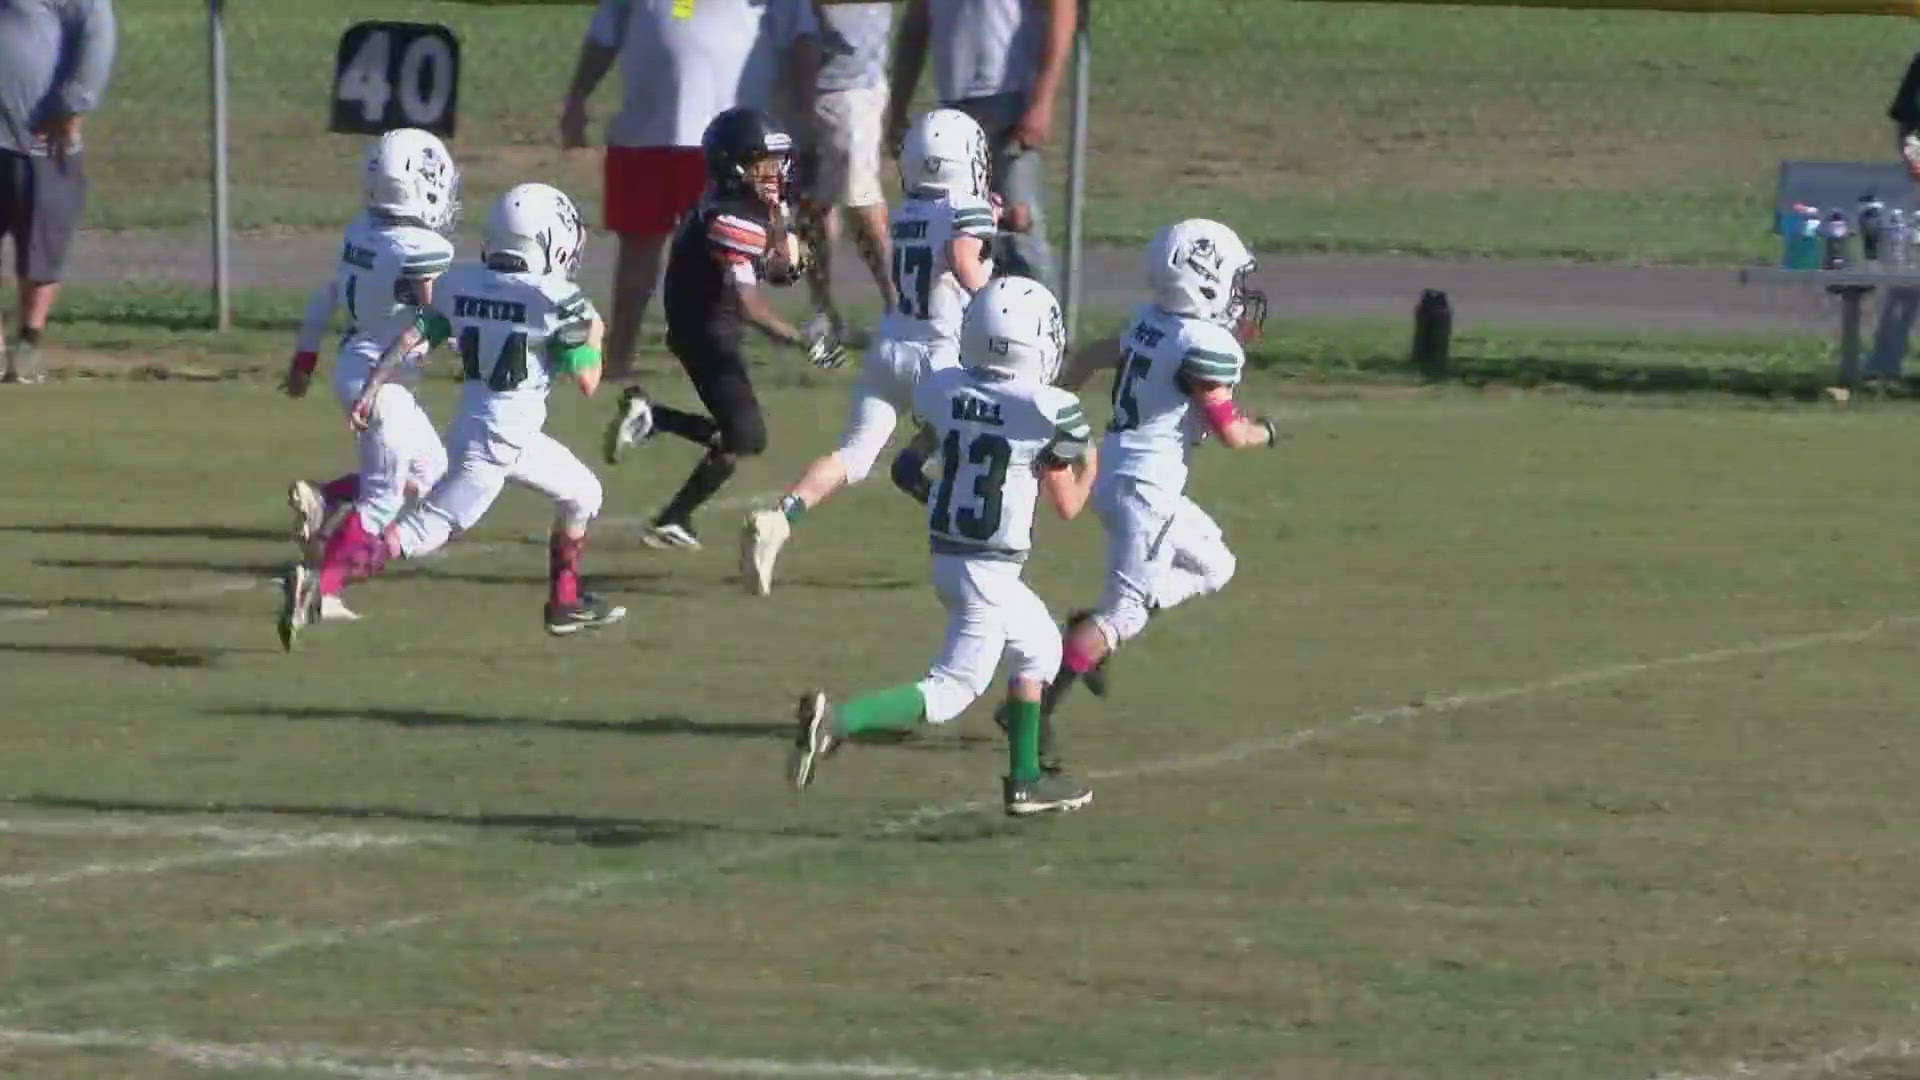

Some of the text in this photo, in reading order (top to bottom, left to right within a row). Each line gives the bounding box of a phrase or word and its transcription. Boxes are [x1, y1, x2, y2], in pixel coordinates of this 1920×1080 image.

[339, 30, 454, 124] 40
[463, 325, 528, 392] 14
[930, 428, 1012, 540] 13
